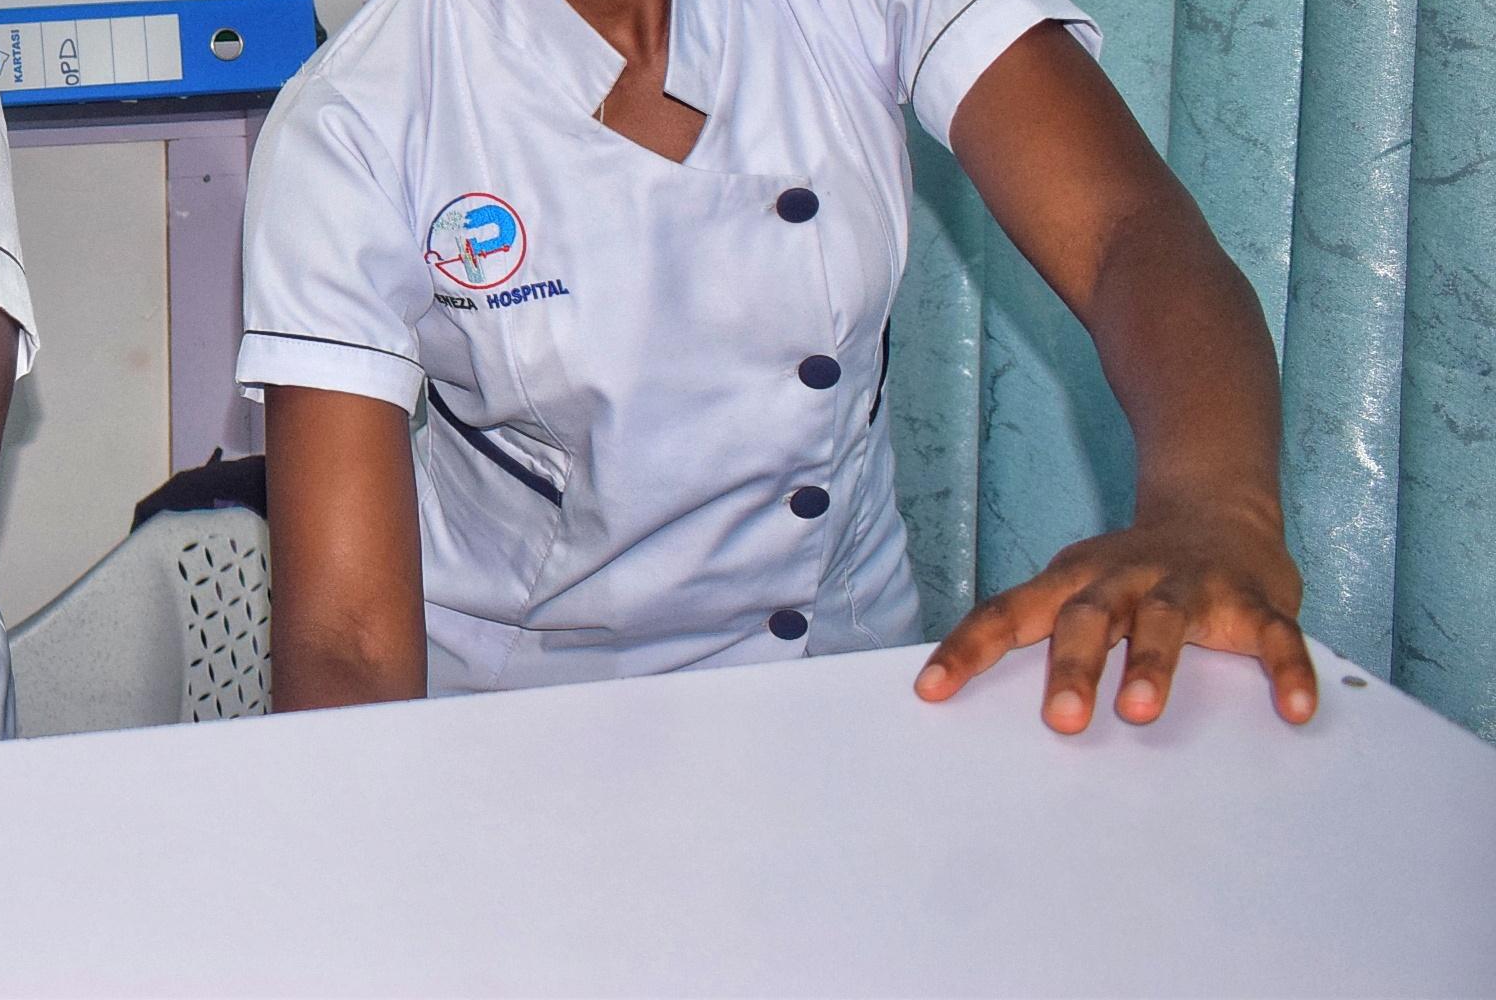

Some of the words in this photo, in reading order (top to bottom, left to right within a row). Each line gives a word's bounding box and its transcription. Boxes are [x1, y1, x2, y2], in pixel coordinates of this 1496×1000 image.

[10, 29, 23, 83] KARTASI
[59, 38, 80, 86] OPD
[486, 279, 570, 310] HOSPITAL
